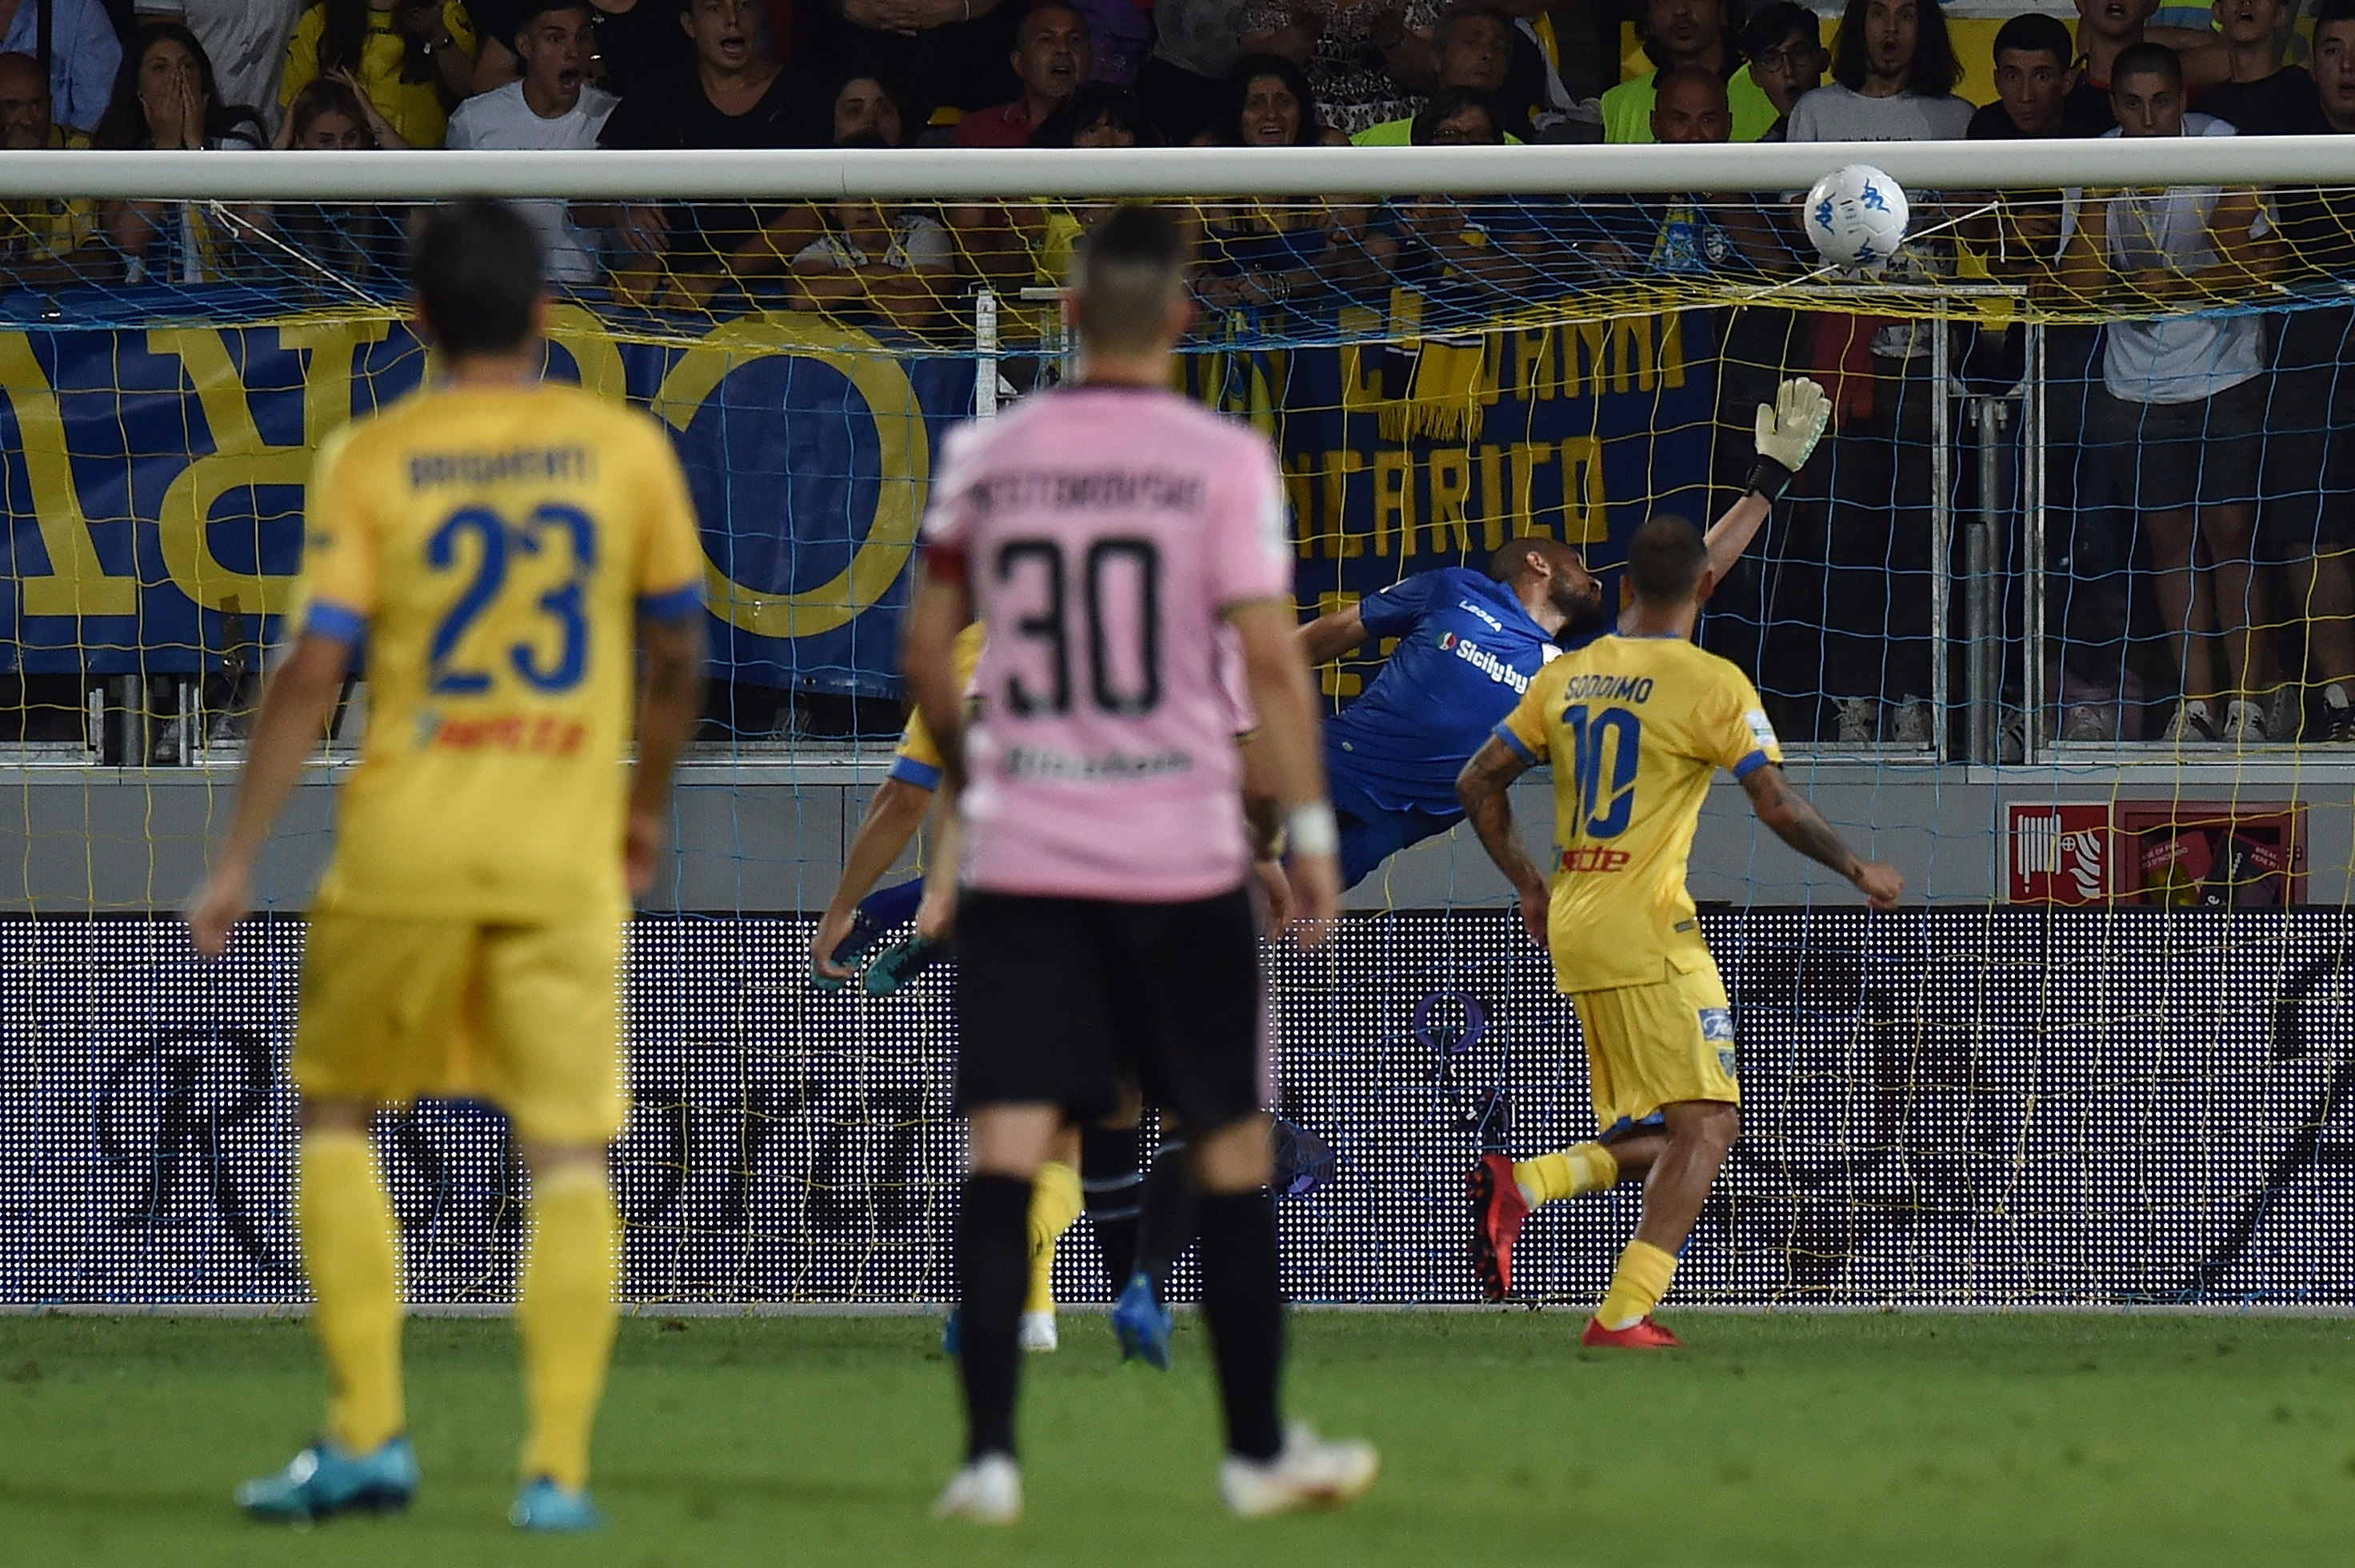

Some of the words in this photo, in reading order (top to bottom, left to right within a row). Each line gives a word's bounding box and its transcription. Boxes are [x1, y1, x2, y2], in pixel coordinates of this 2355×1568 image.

[429, 503, 597, 695] 23
[996, 538, 1164, 718] 30
[1456, 639, 1534, 695] Sicilyby
[1565, 674, 1653, 705] SODDIMO
[1562, 704, 1641, 838] 10
